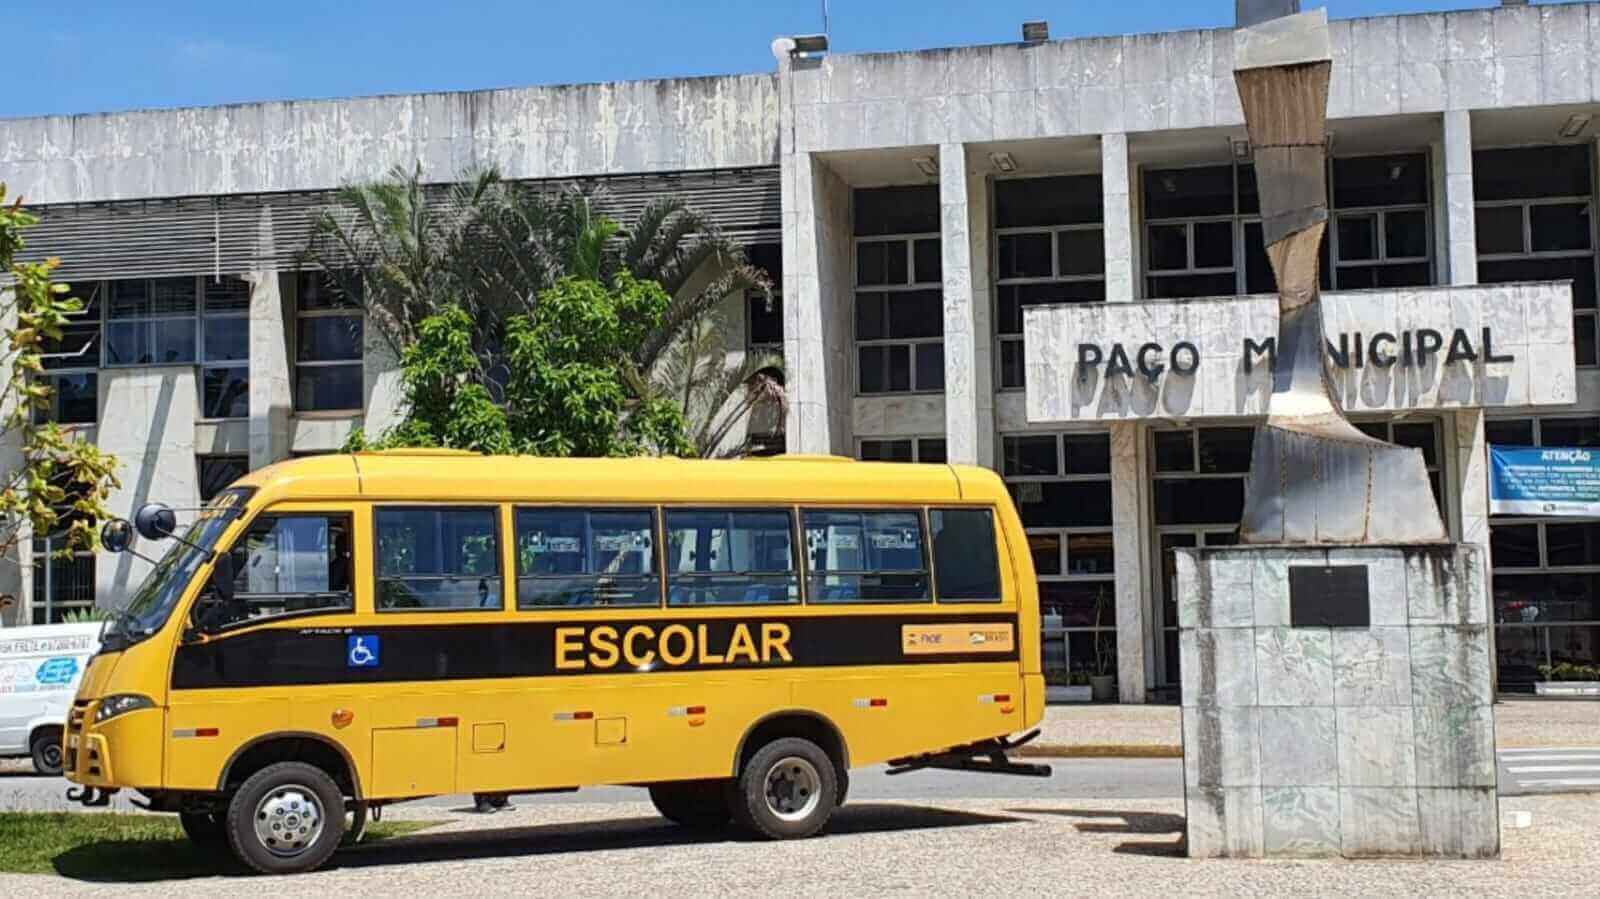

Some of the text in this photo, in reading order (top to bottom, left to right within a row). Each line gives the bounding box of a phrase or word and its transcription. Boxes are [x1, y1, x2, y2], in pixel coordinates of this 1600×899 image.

[1077, 327, 1515, 385] PAÇO MNICIPAL
[1541, 449, 1591, 464] ATENÇÃO
[555, 623, 793, 669] ESCOLAR
